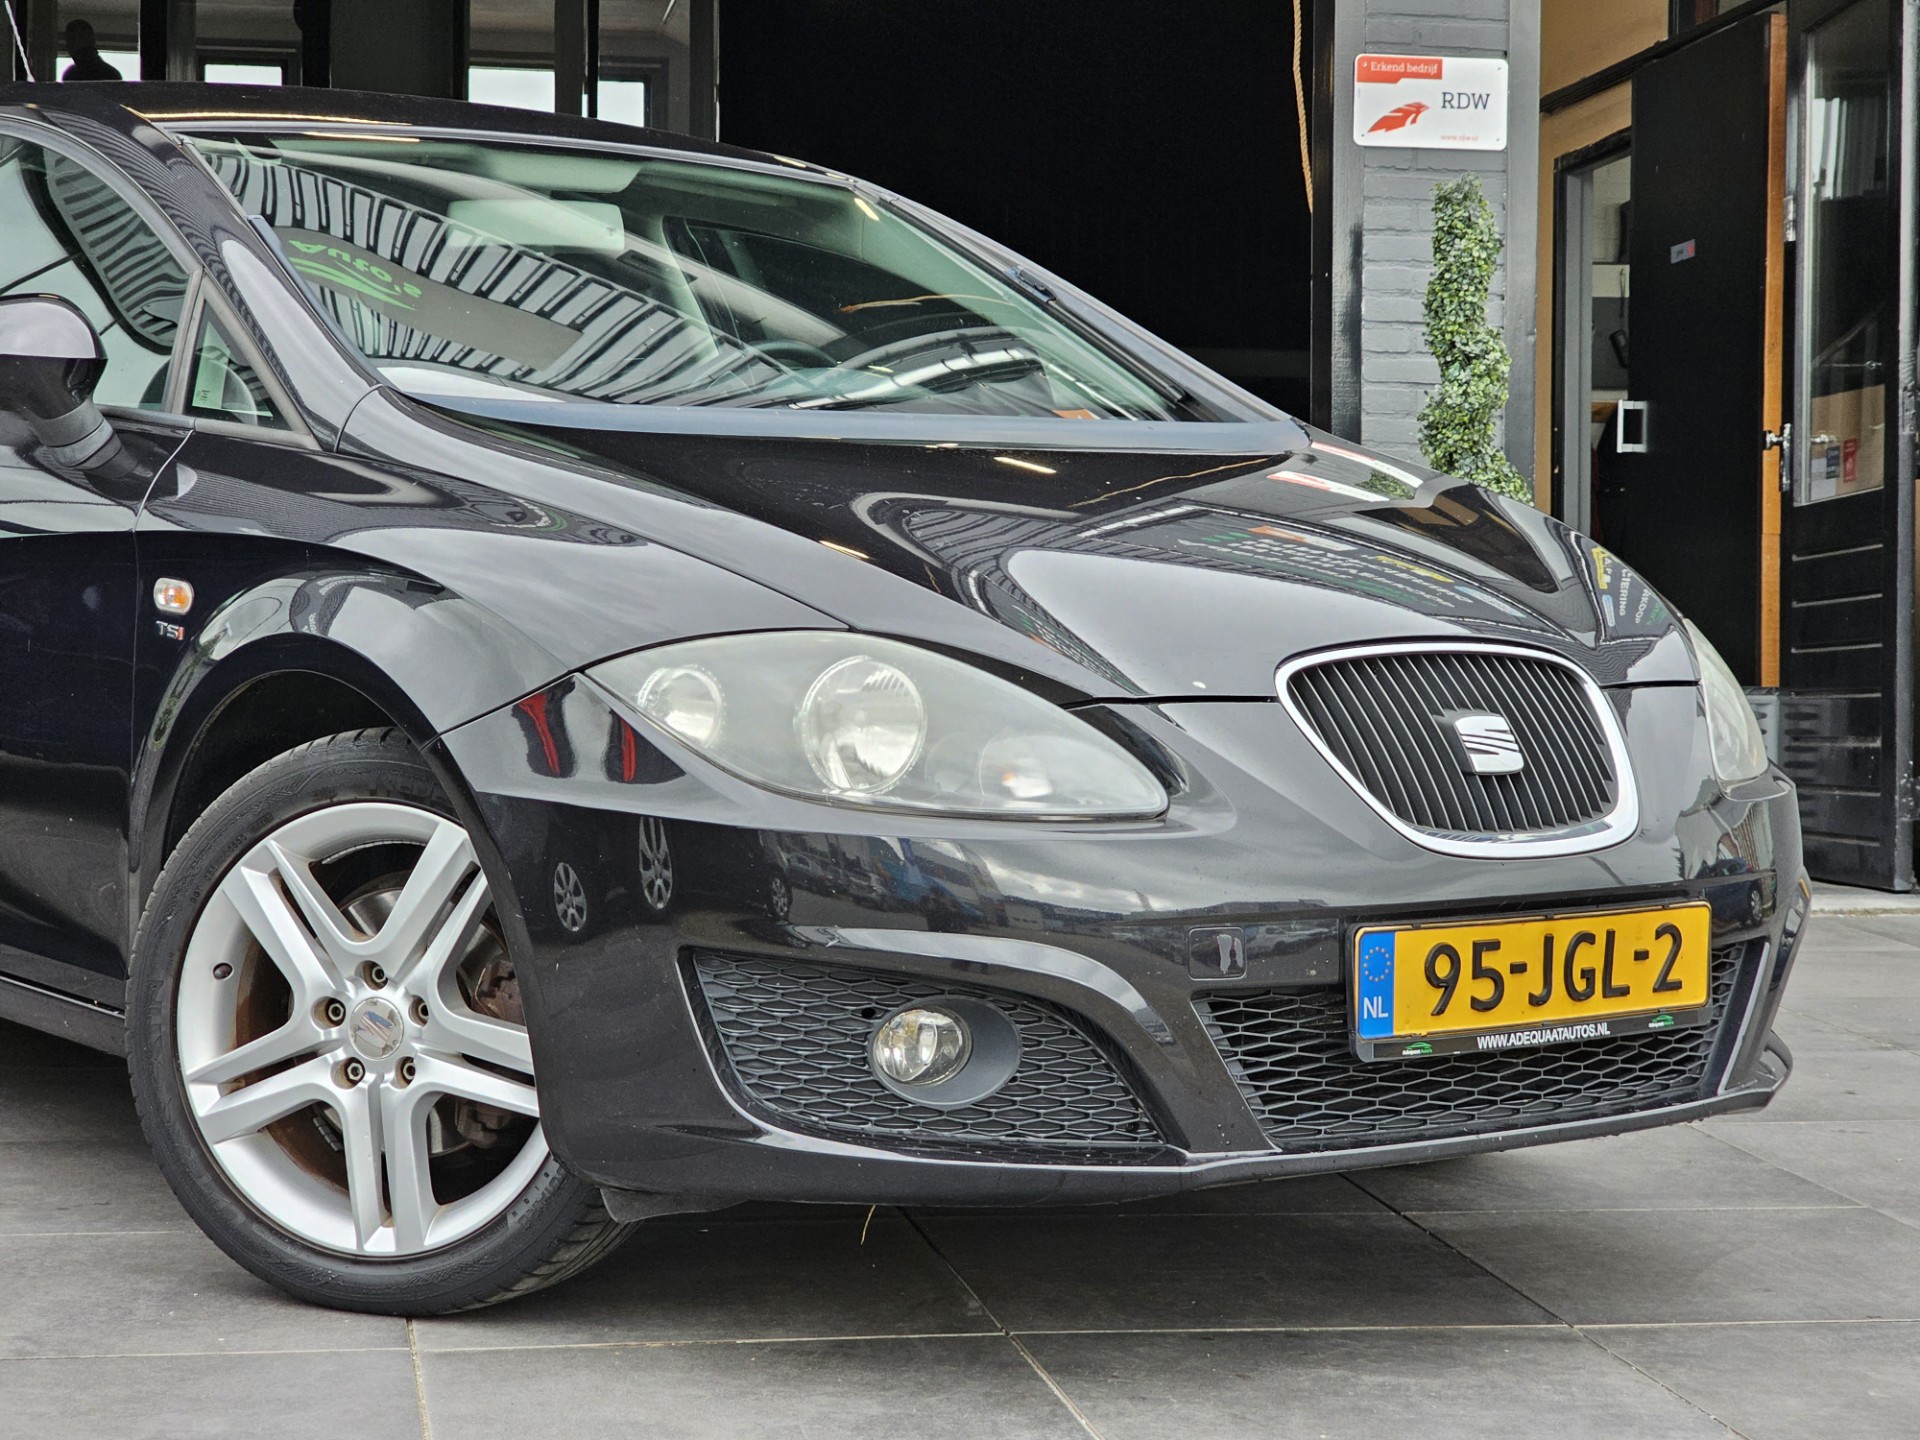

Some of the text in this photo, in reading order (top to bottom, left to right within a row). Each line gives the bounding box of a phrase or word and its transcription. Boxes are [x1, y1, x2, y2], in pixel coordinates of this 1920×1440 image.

[1370, 61, 1438, 75] Erkend bedrijf
[1441, 91, 1491, 110] RDW
[155, 620, 184, 641] TSI
[1423, 921, 1684, 1017] 95-JGL-2
[1363, 995, 1389, 1020] NL
[1476, 1022, 1611, 1050] WWW.ADEQUAATAUTOS.NL
